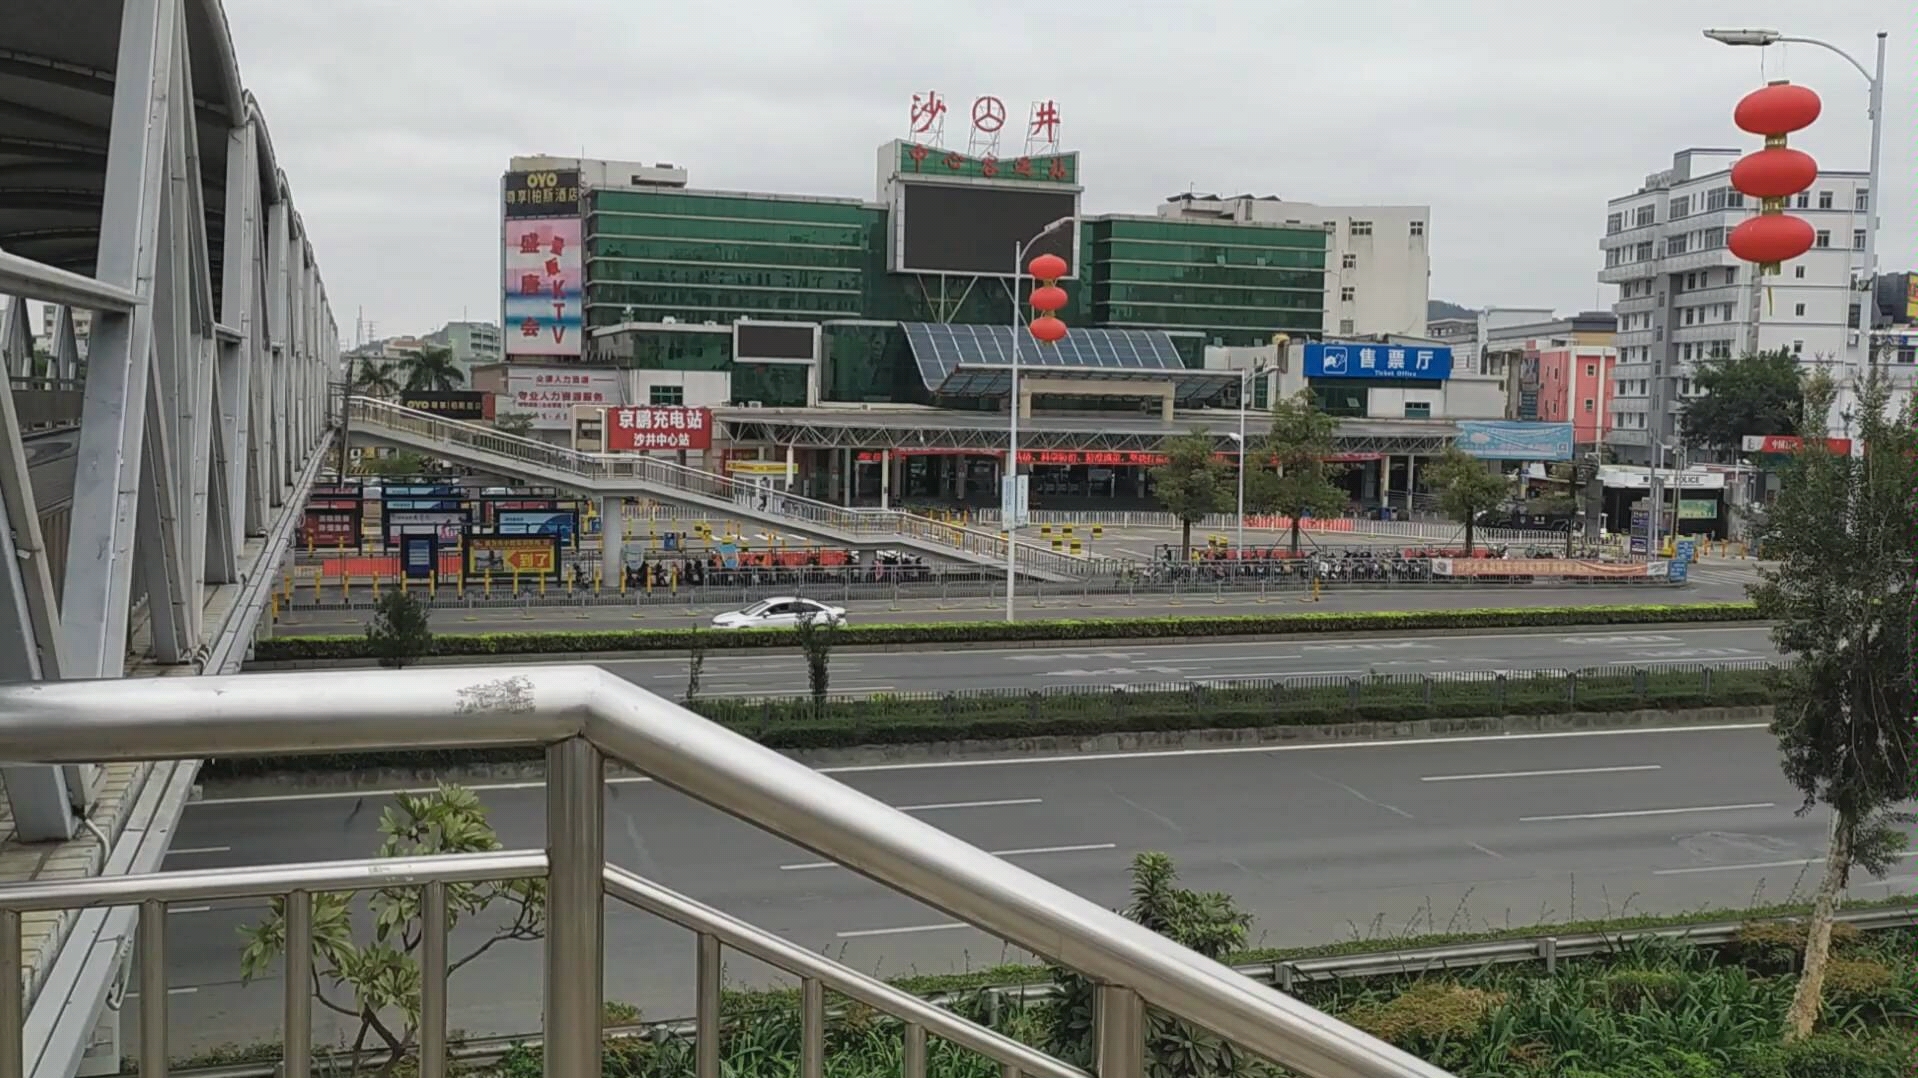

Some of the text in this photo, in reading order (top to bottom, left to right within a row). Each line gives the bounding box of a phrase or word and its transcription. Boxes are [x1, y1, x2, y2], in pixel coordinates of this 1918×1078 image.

[911, 91, 1060, 143] 沙 井
[527, 172, 558, 188] OYO
[1359, 347, 1434, 370] 售票厅
[618, 409, 703, 429] 京鹏充电站
[633, 433, 690, 447] 沙井中心站
[519, 553, 549, 568] 到了
